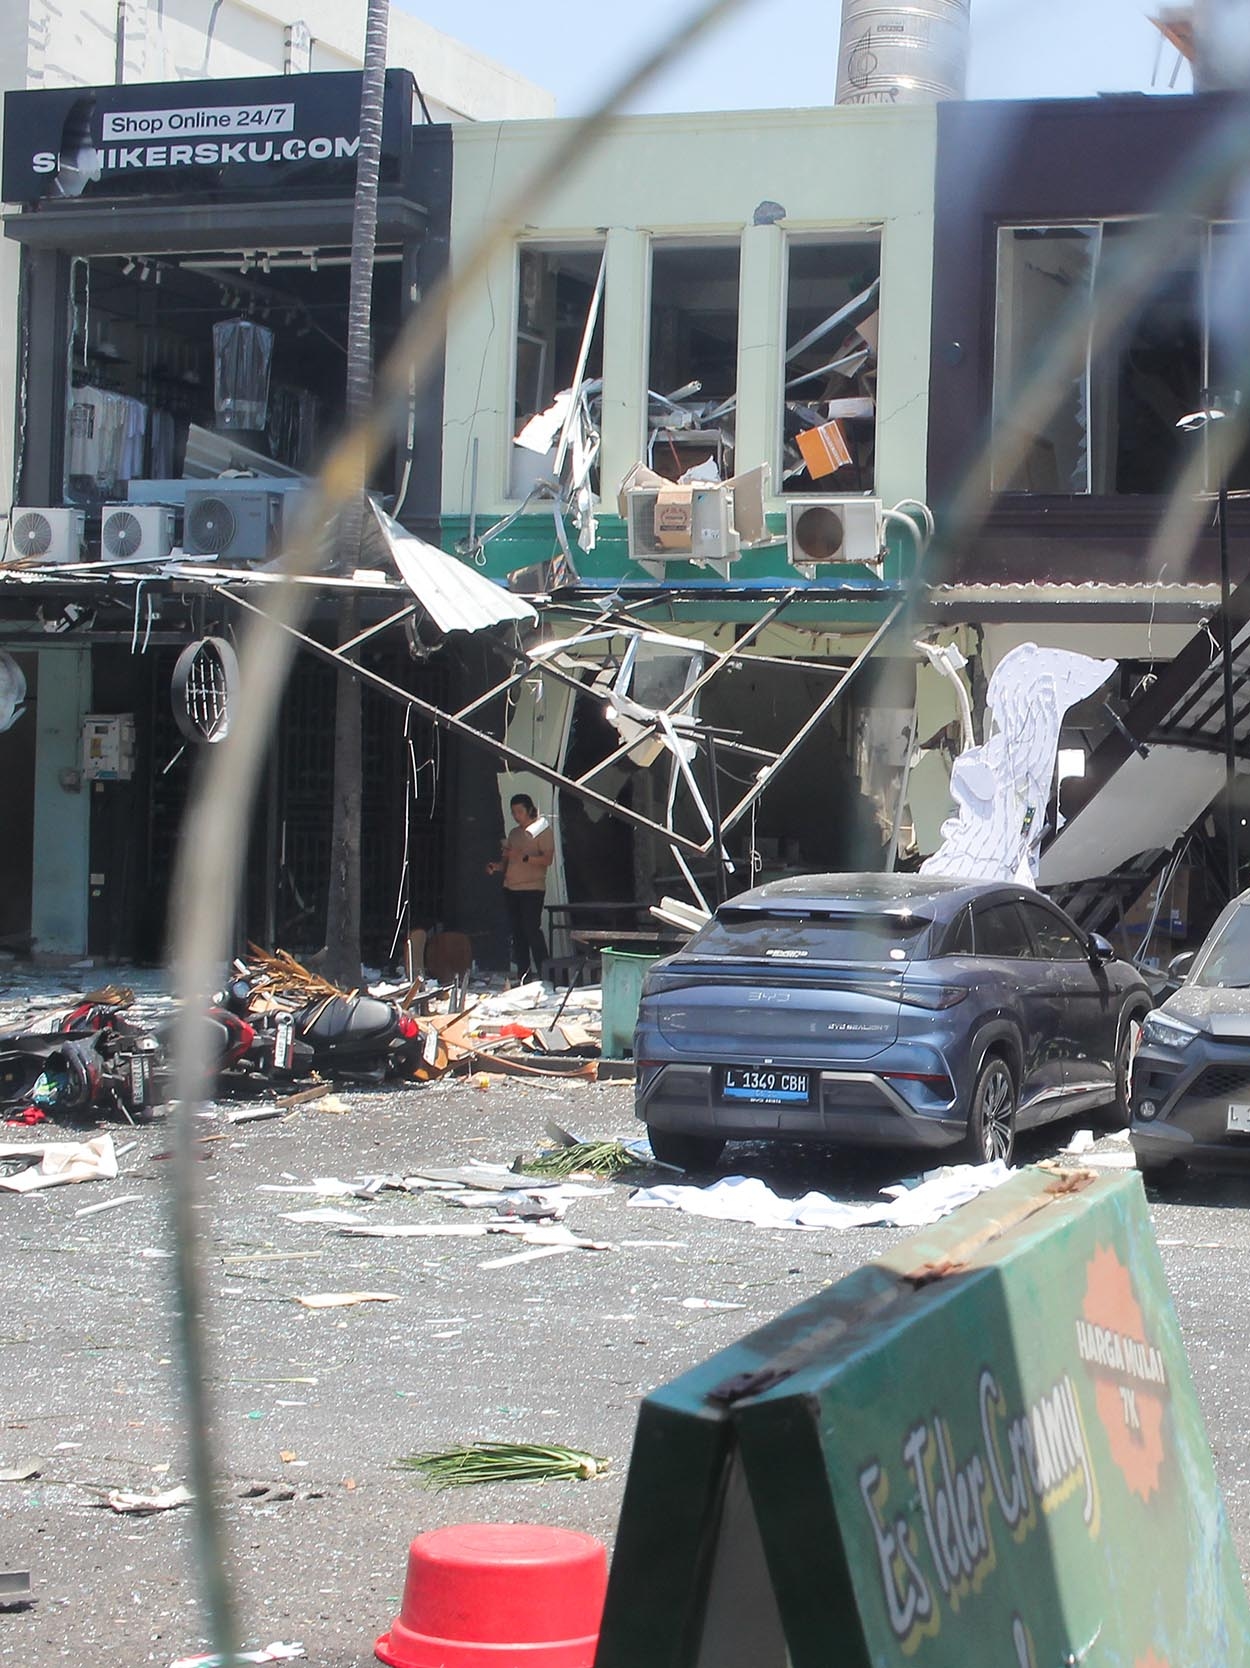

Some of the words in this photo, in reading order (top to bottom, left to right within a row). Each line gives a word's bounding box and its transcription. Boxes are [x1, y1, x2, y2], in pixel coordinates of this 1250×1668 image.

[111, 116, 163, 133] Shop
[168, 112, 231, 130] Online
[237, 108, 287, 126] 24/7
[32, 136, 361, 173] SIKERSKU.COM
[726, 1071, 735, 1087] L
[742, 1072, 776, 1090] 1349
[781, 1075, 806, 1092] CBH
[1230, 1106, 1239, 1121] L
[1075, 1319, 1125, 1371] HARGA
[1122, 1337, 1166, 1385] MULAI
[1118, 1385, 1140, 1428] 7K
[859, 1458, 932, 1637] Es
[904, 1416, 990, 1595] Teler
